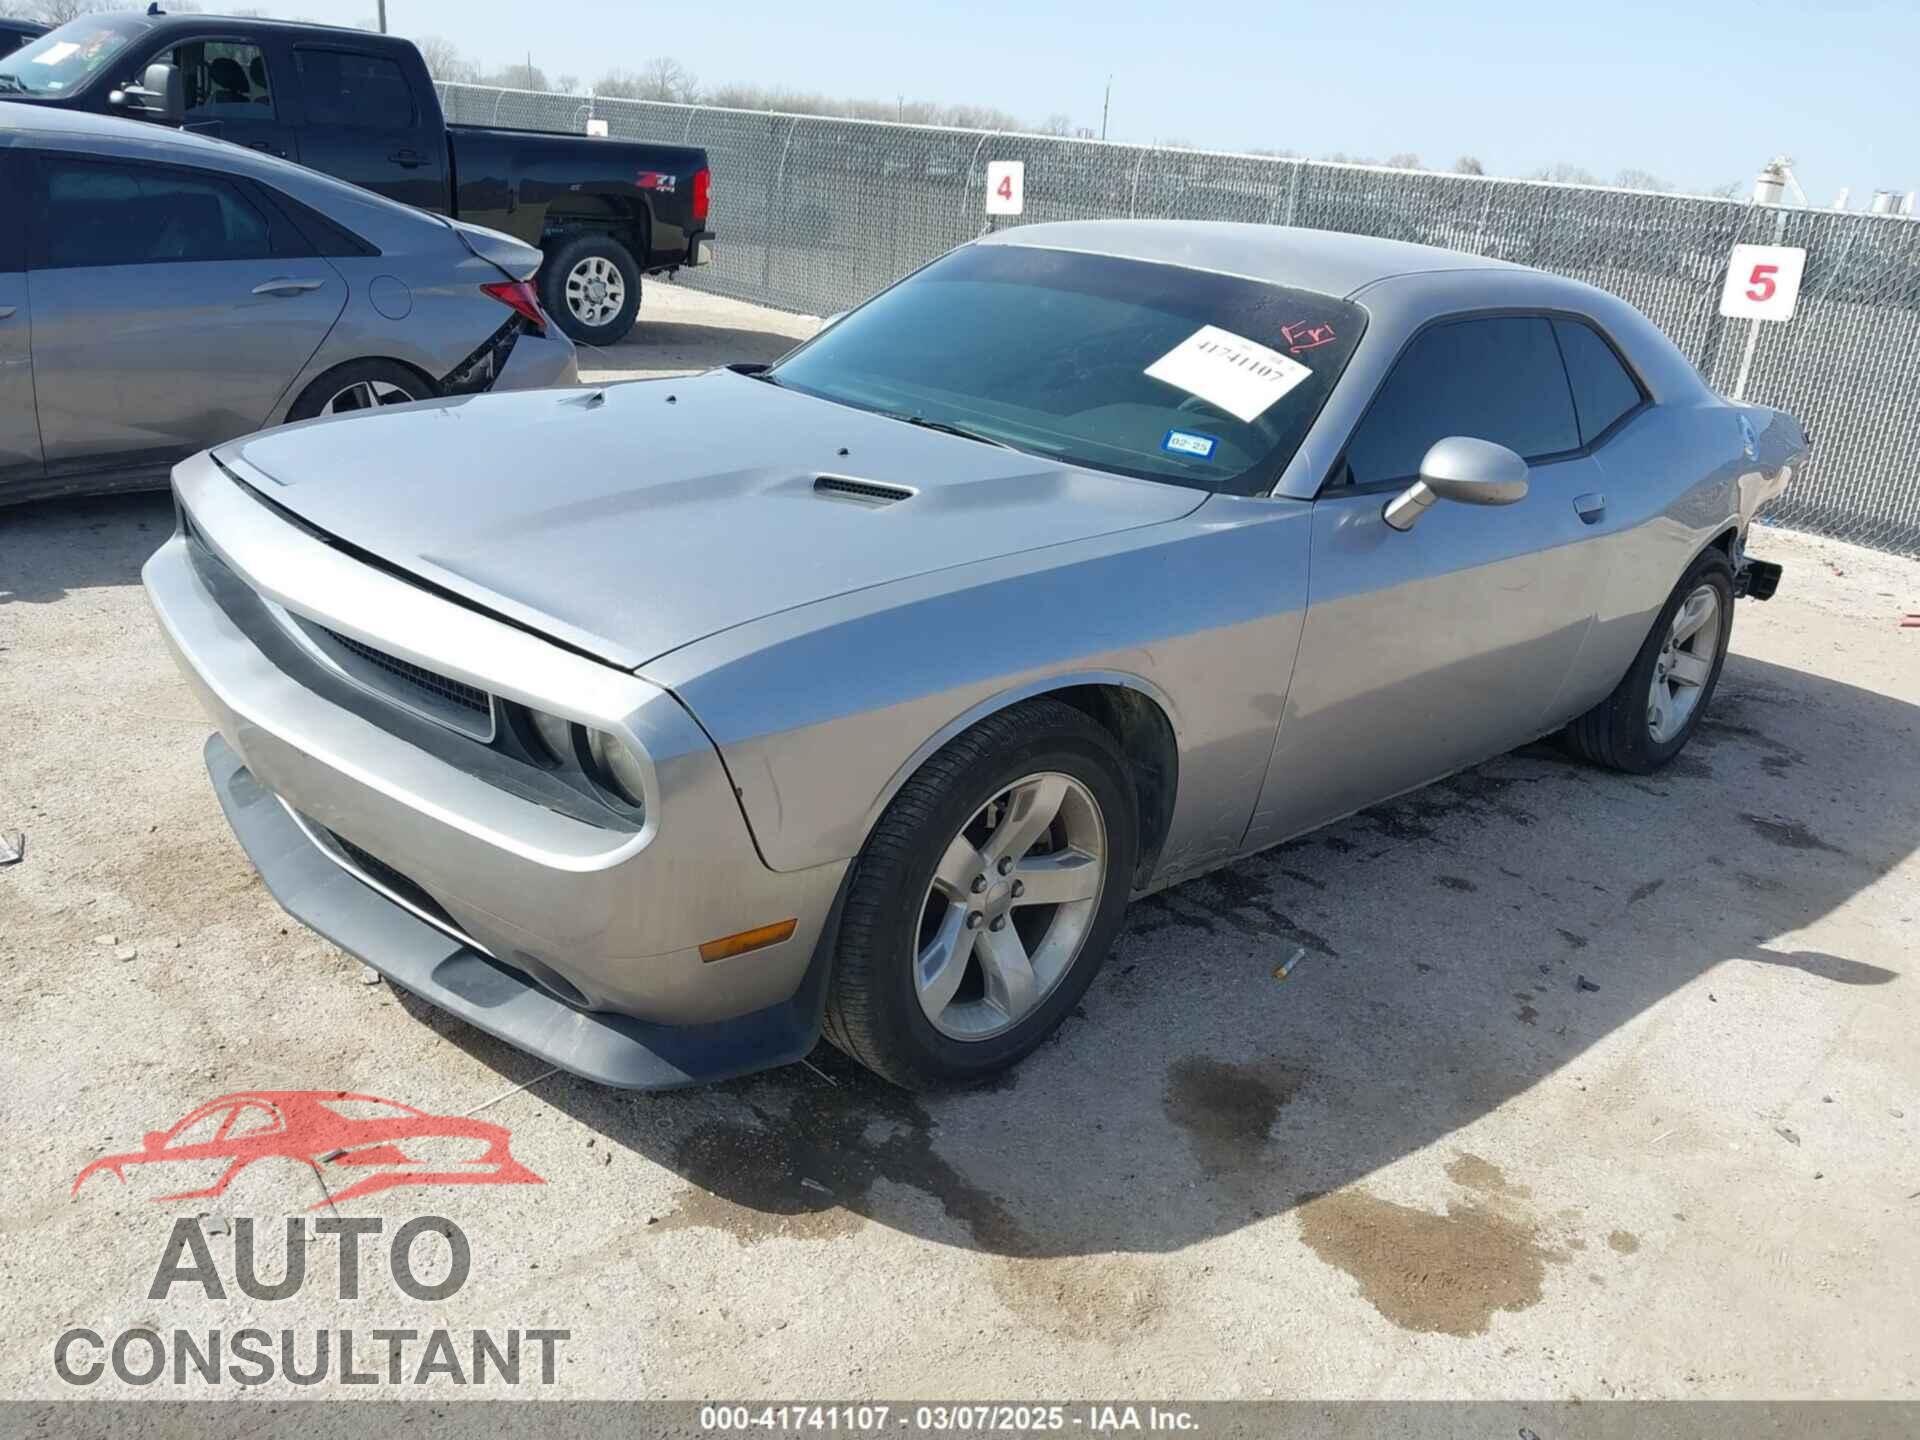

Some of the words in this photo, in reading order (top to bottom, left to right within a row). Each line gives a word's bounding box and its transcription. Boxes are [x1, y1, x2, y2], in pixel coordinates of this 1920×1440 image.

[997, 175, 1012, 201] 4
[1745, 264, 1779, 302] 5
[1197, 341, 1285, 382] 41741107
